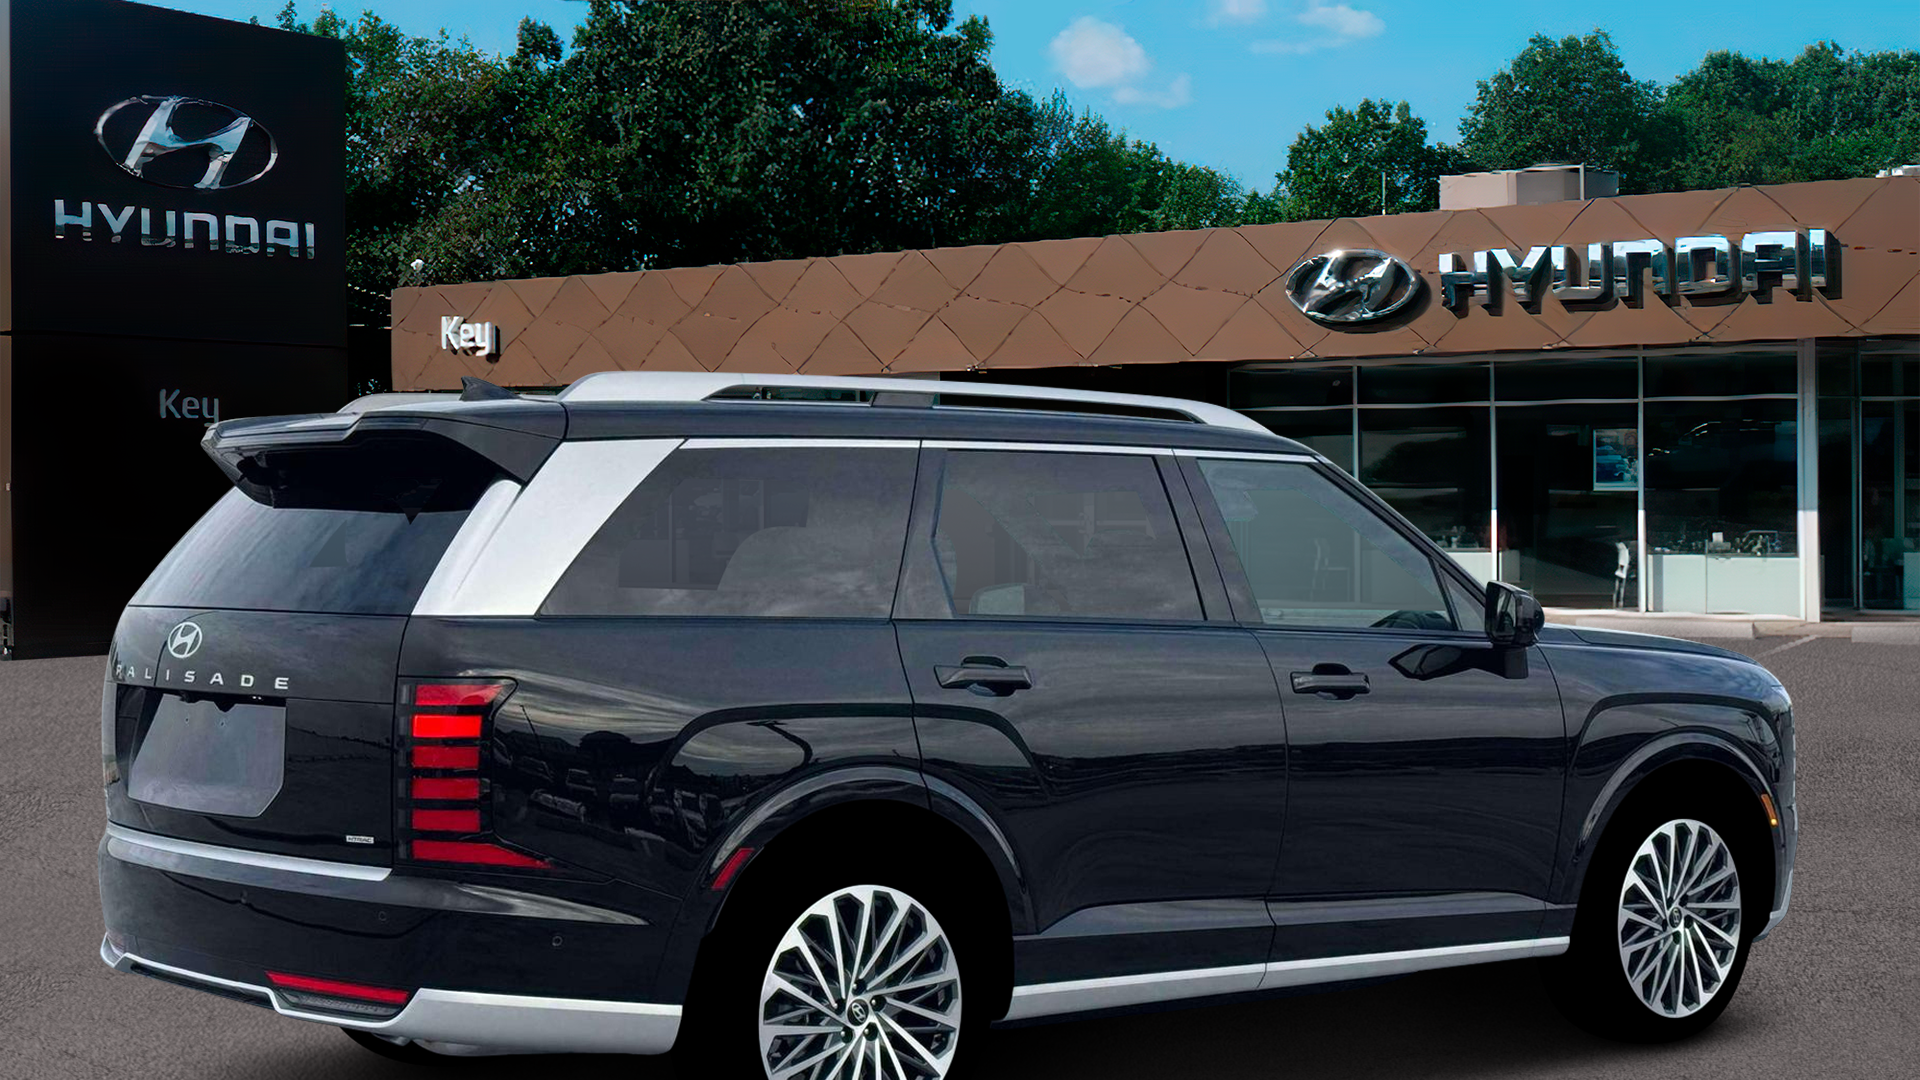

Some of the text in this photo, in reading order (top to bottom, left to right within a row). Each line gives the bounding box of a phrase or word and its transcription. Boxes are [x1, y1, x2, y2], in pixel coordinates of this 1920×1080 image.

[55, 199, 315, 259] HYUNDAI
[1438, 228, 1842, 318] HYUNDAI
[441, 315, 493, 357] Key
[159, 388, 220, 427] Key
